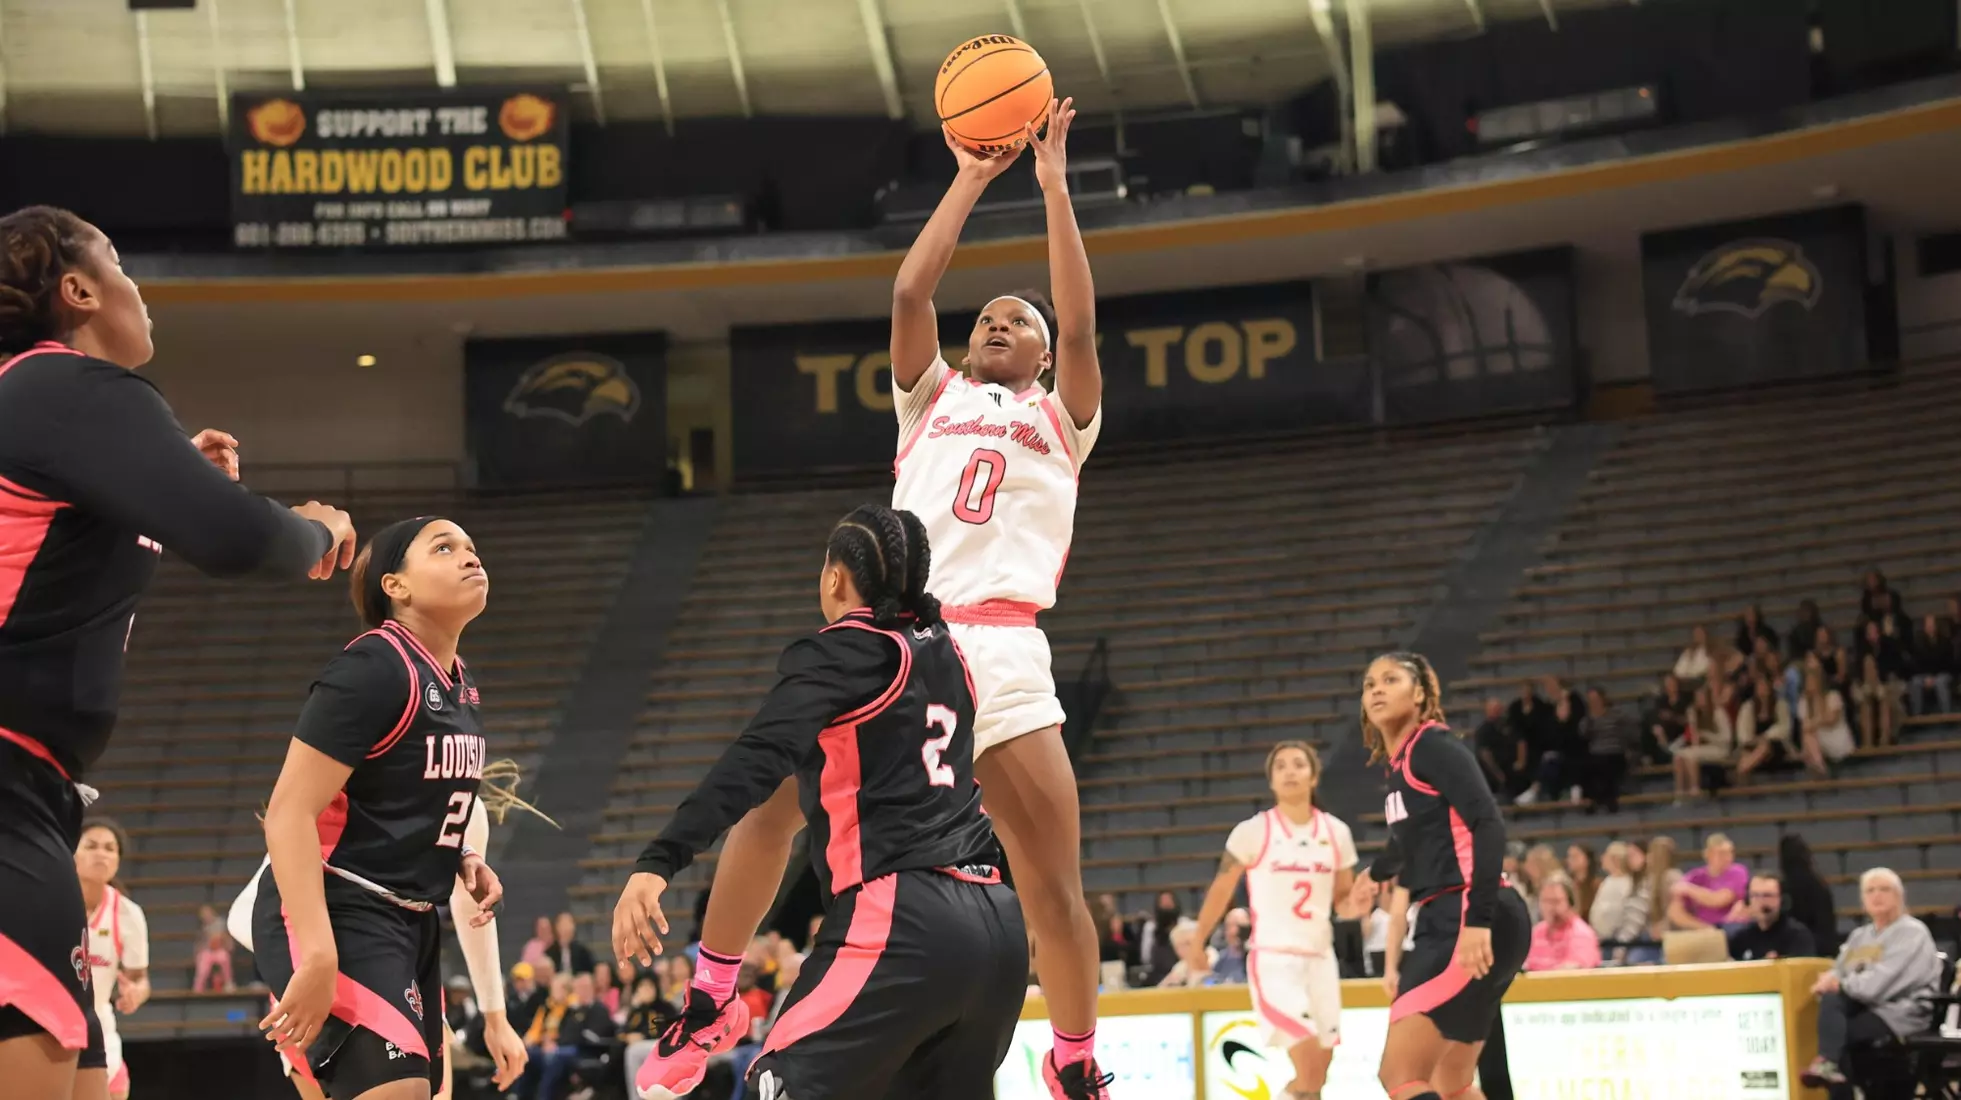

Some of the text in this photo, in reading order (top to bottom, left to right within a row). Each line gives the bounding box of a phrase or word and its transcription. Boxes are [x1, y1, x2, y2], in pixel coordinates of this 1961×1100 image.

[942, 35, 1017, 74] Wilson
[317, 106, 488, 137] SUPPORT THE
[241, 143, 561, 194] HARDWOOD CLUB
[1124, 317, 1297, 387] TOP
[928, 415, 1050, 455] Southern Miss
[952, 448, 1006, 525] 0
[921, 703, 957, 788] 2
[1292, 881, 1312, 920] 2
